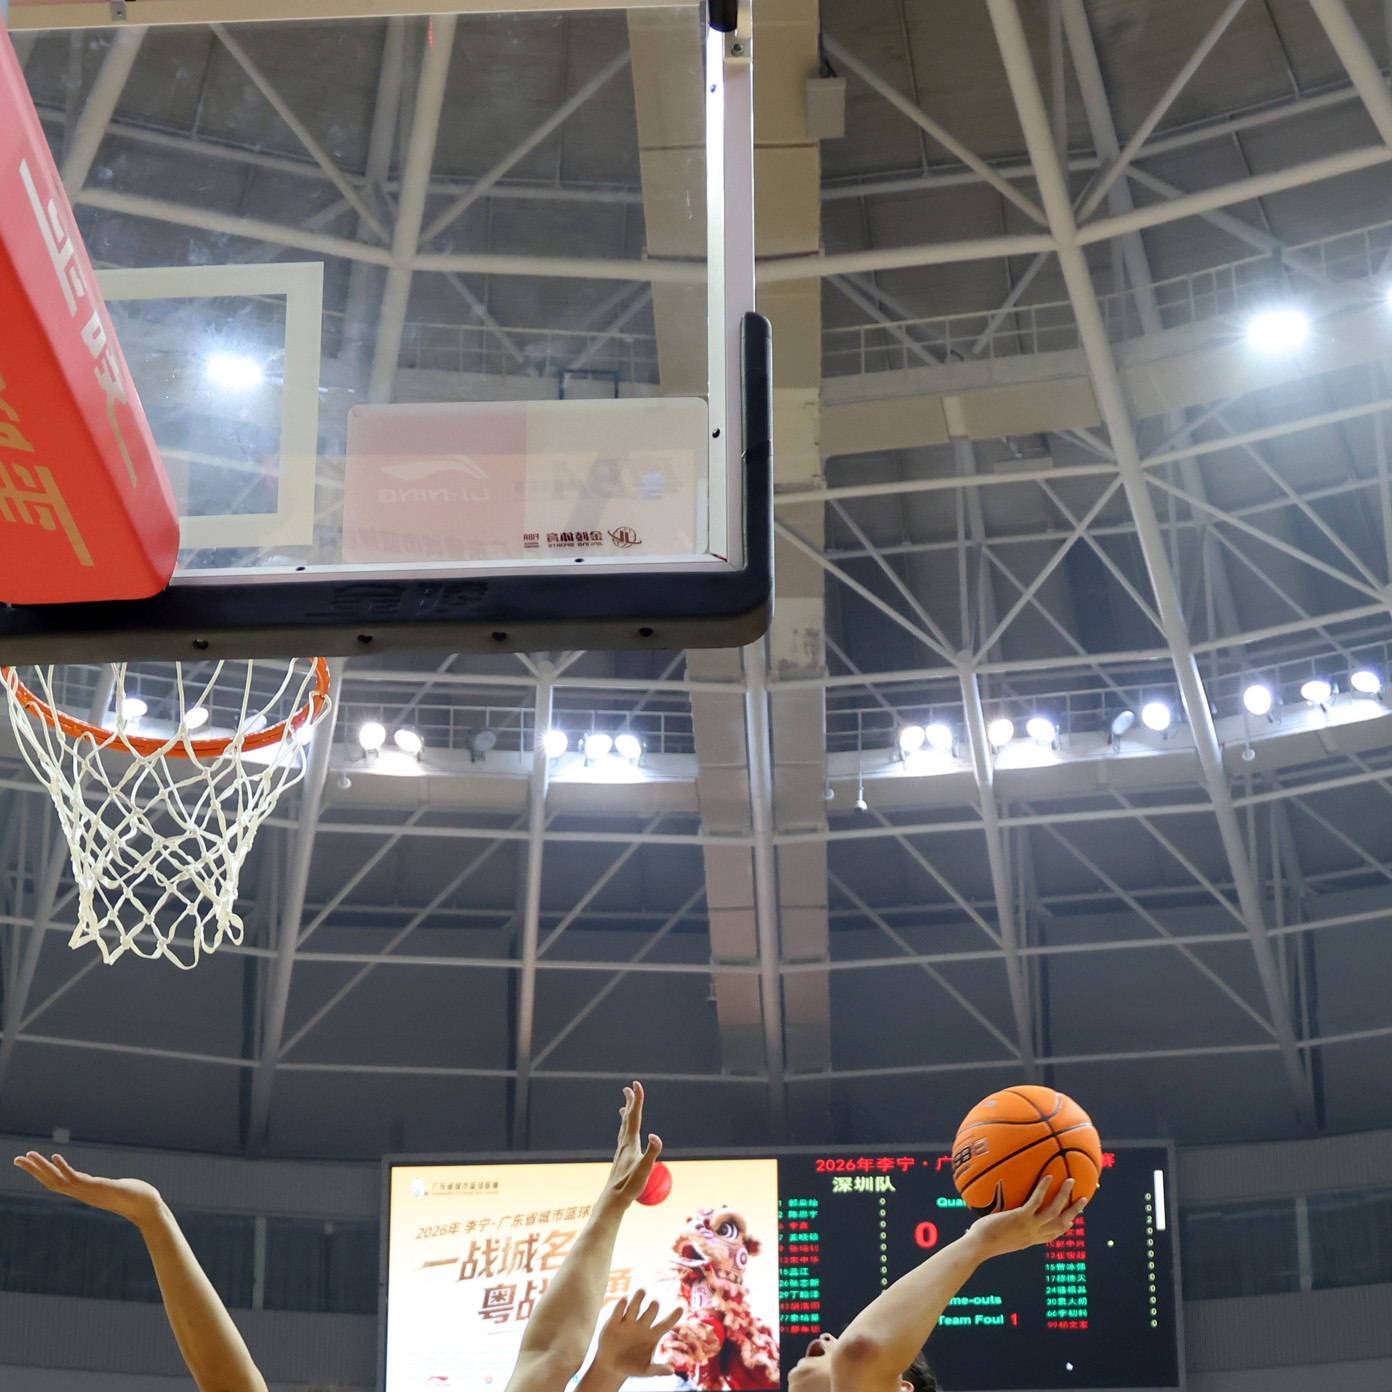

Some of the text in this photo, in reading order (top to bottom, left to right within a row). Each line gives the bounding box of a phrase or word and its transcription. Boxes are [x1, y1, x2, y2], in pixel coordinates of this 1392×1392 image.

[832, 1176, 896, 1193] 深圳队
[915, 1221, 938, 1248] 0
[949, 1295, 1002, 1306] me-outs
[975, 1314, 1004, 1325] Foul
[1011, 1312, 1019, 1327] 1
